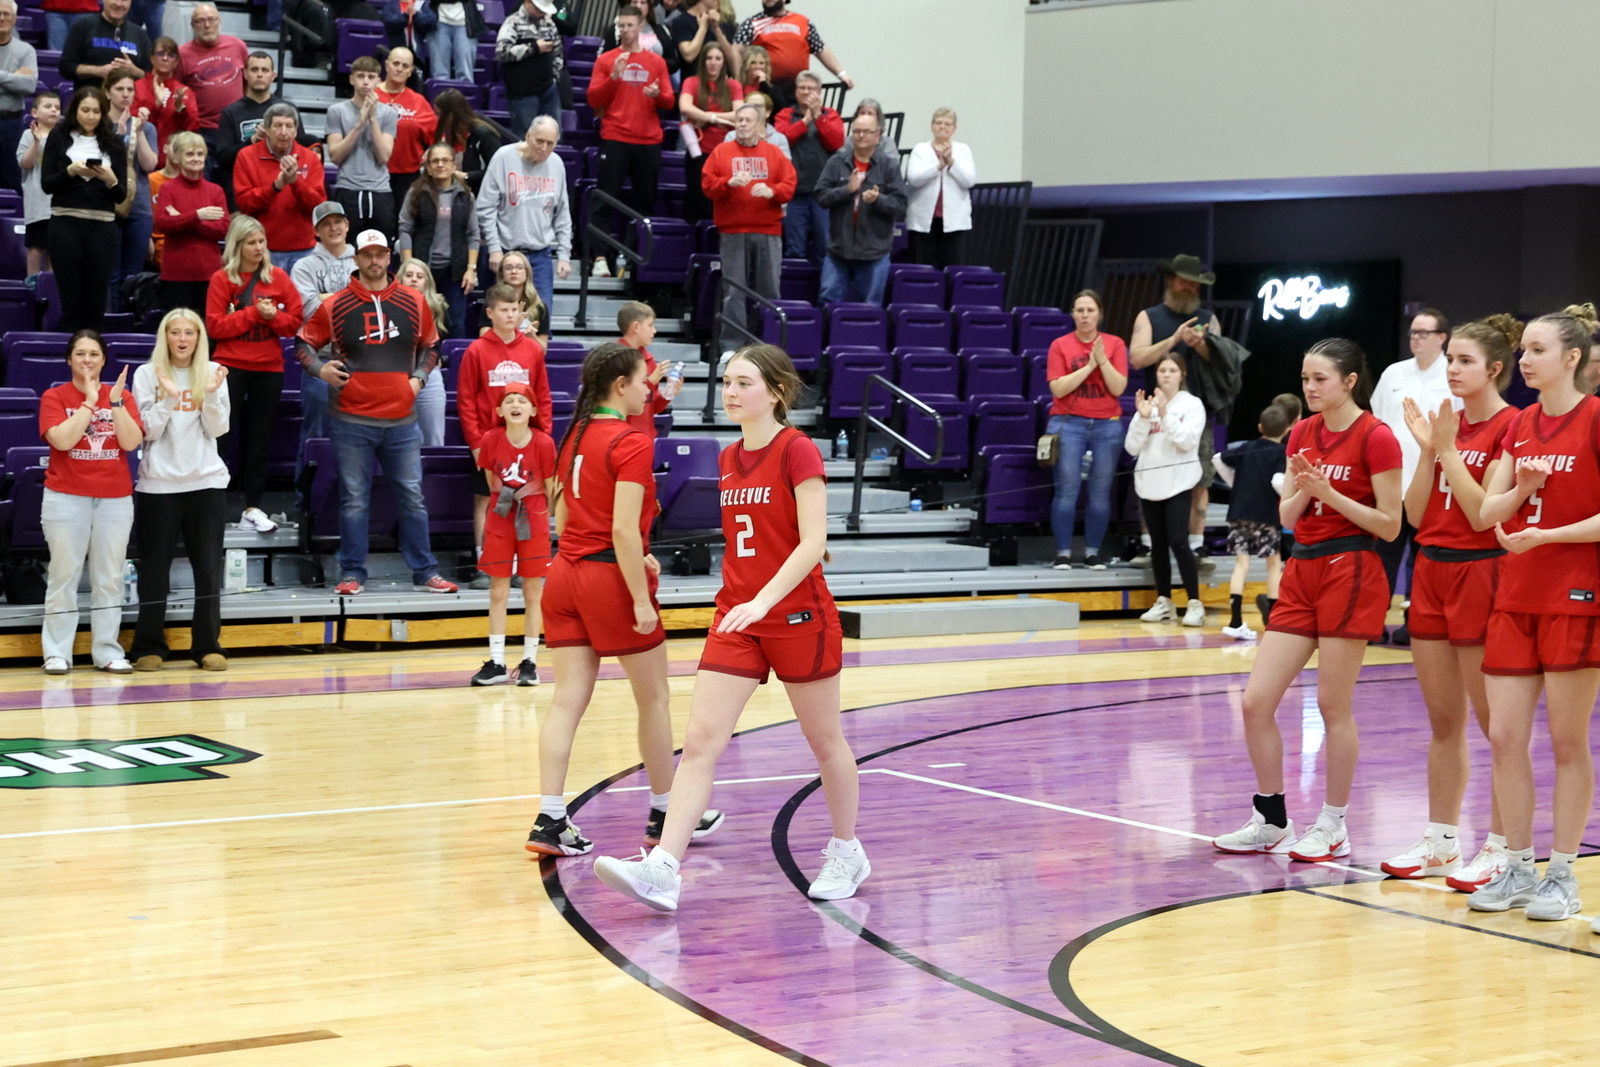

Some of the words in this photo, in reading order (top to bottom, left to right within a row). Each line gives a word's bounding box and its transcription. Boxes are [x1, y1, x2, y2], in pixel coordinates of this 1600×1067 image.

[362, 312, 388, 345] B
[68, 449, 92, 460] STATE
[95, 449, 120, 460] FINAL
[572, 454, 584, 498] 1
[735, 514, 756, 557] 2
